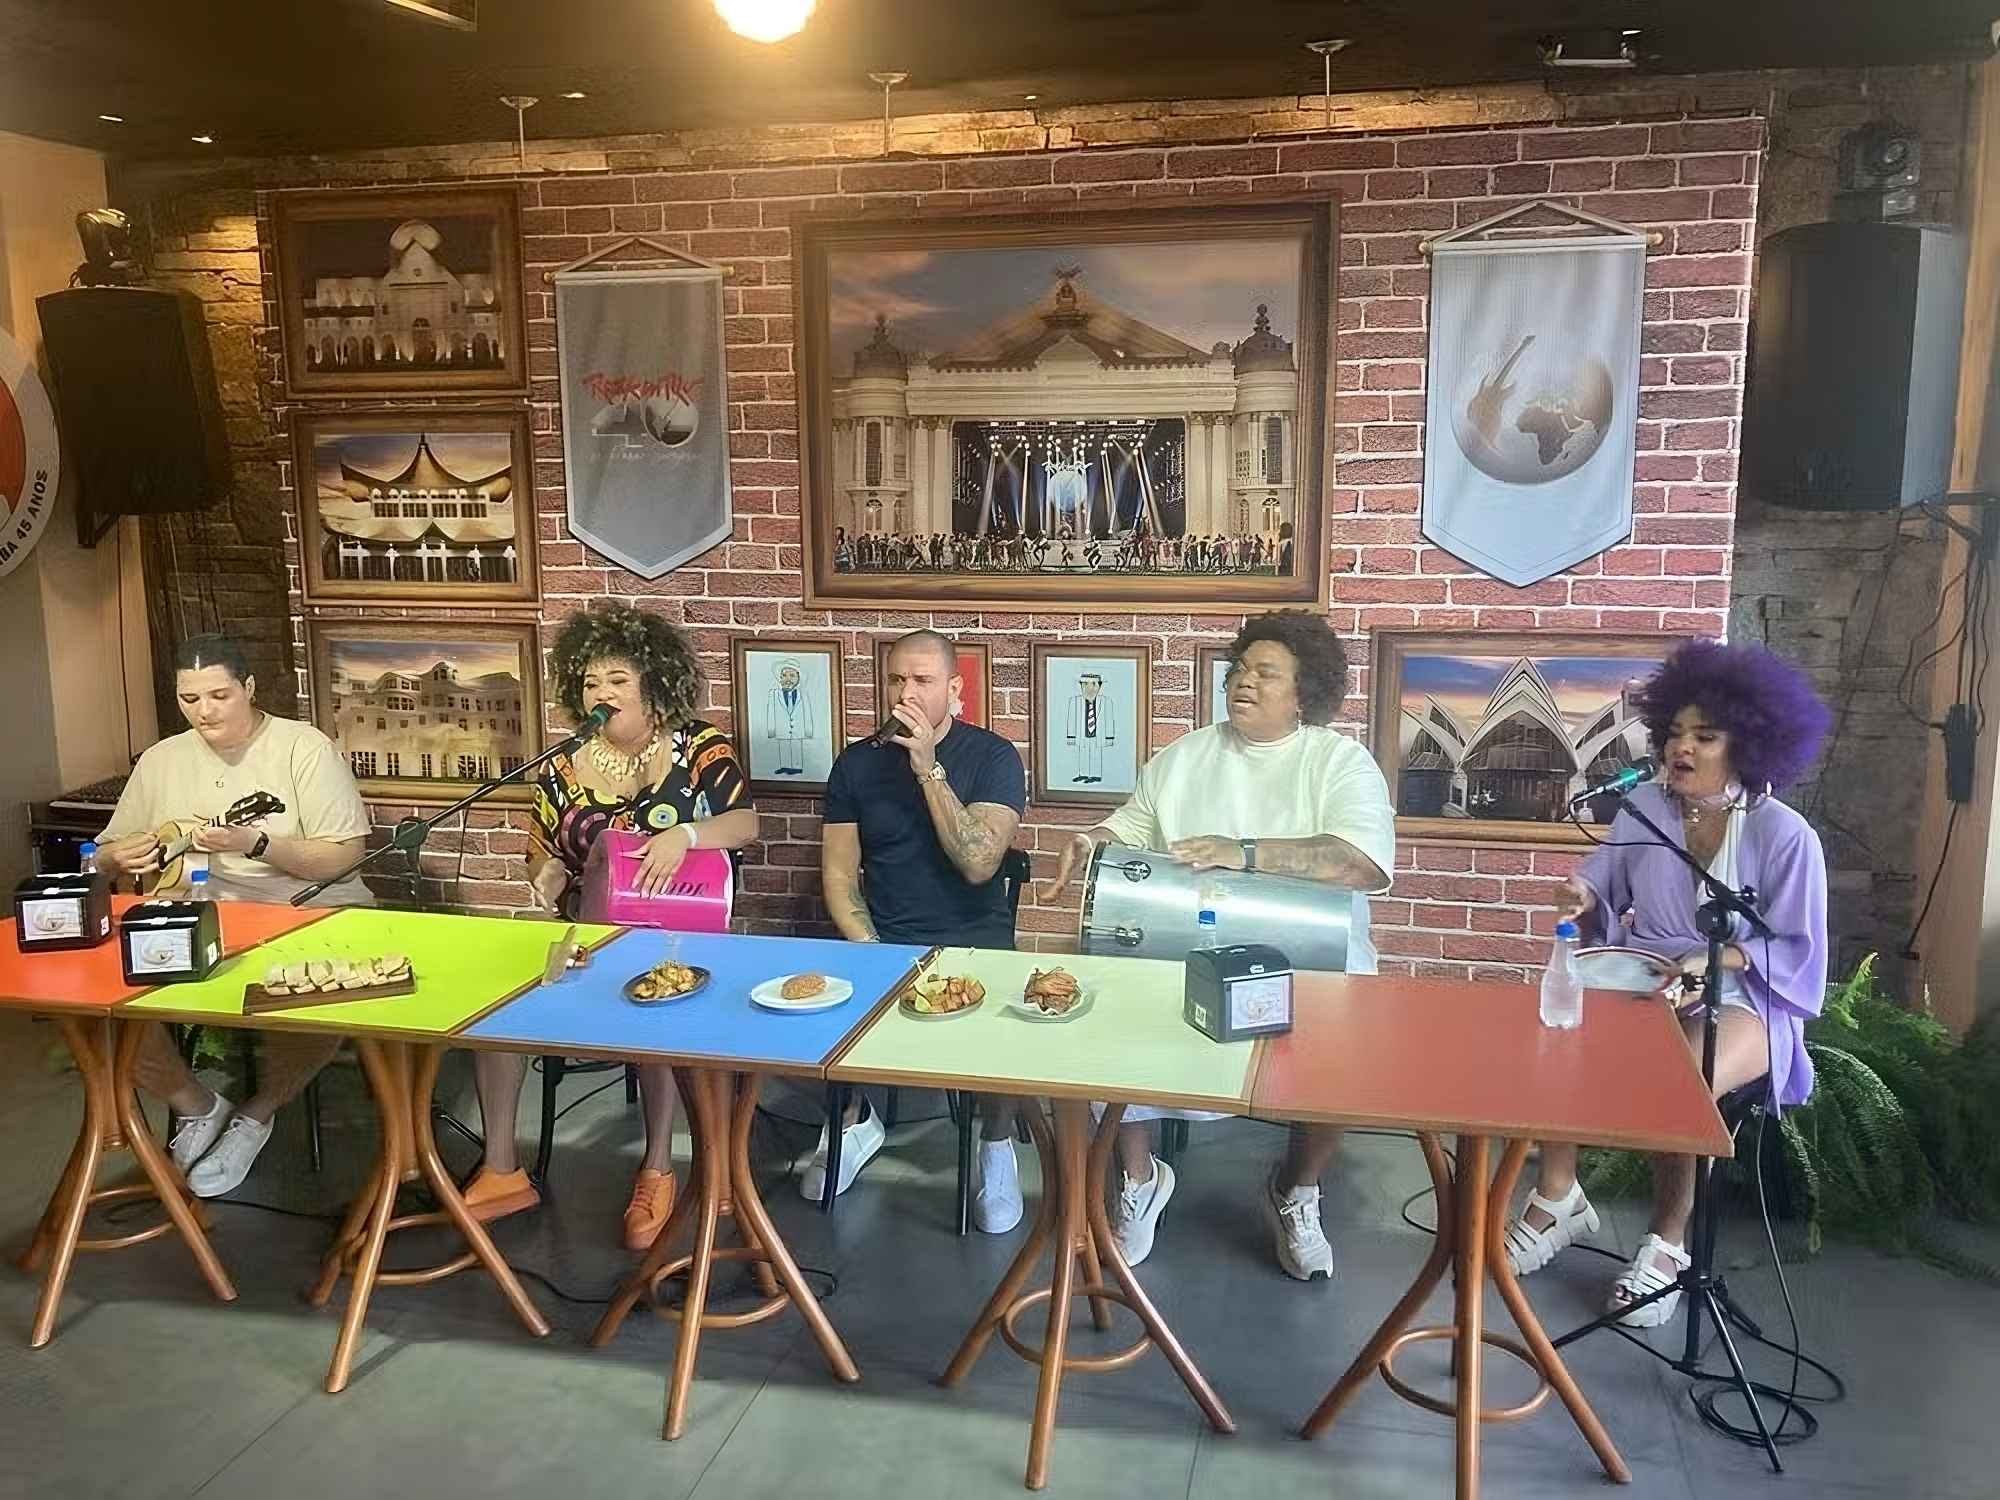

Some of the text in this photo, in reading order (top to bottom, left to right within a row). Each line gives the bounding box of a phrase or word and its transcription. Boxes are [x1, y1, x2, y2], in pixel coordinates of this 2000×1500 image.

[0, 469, 48, 567] BA 45 ANOS
